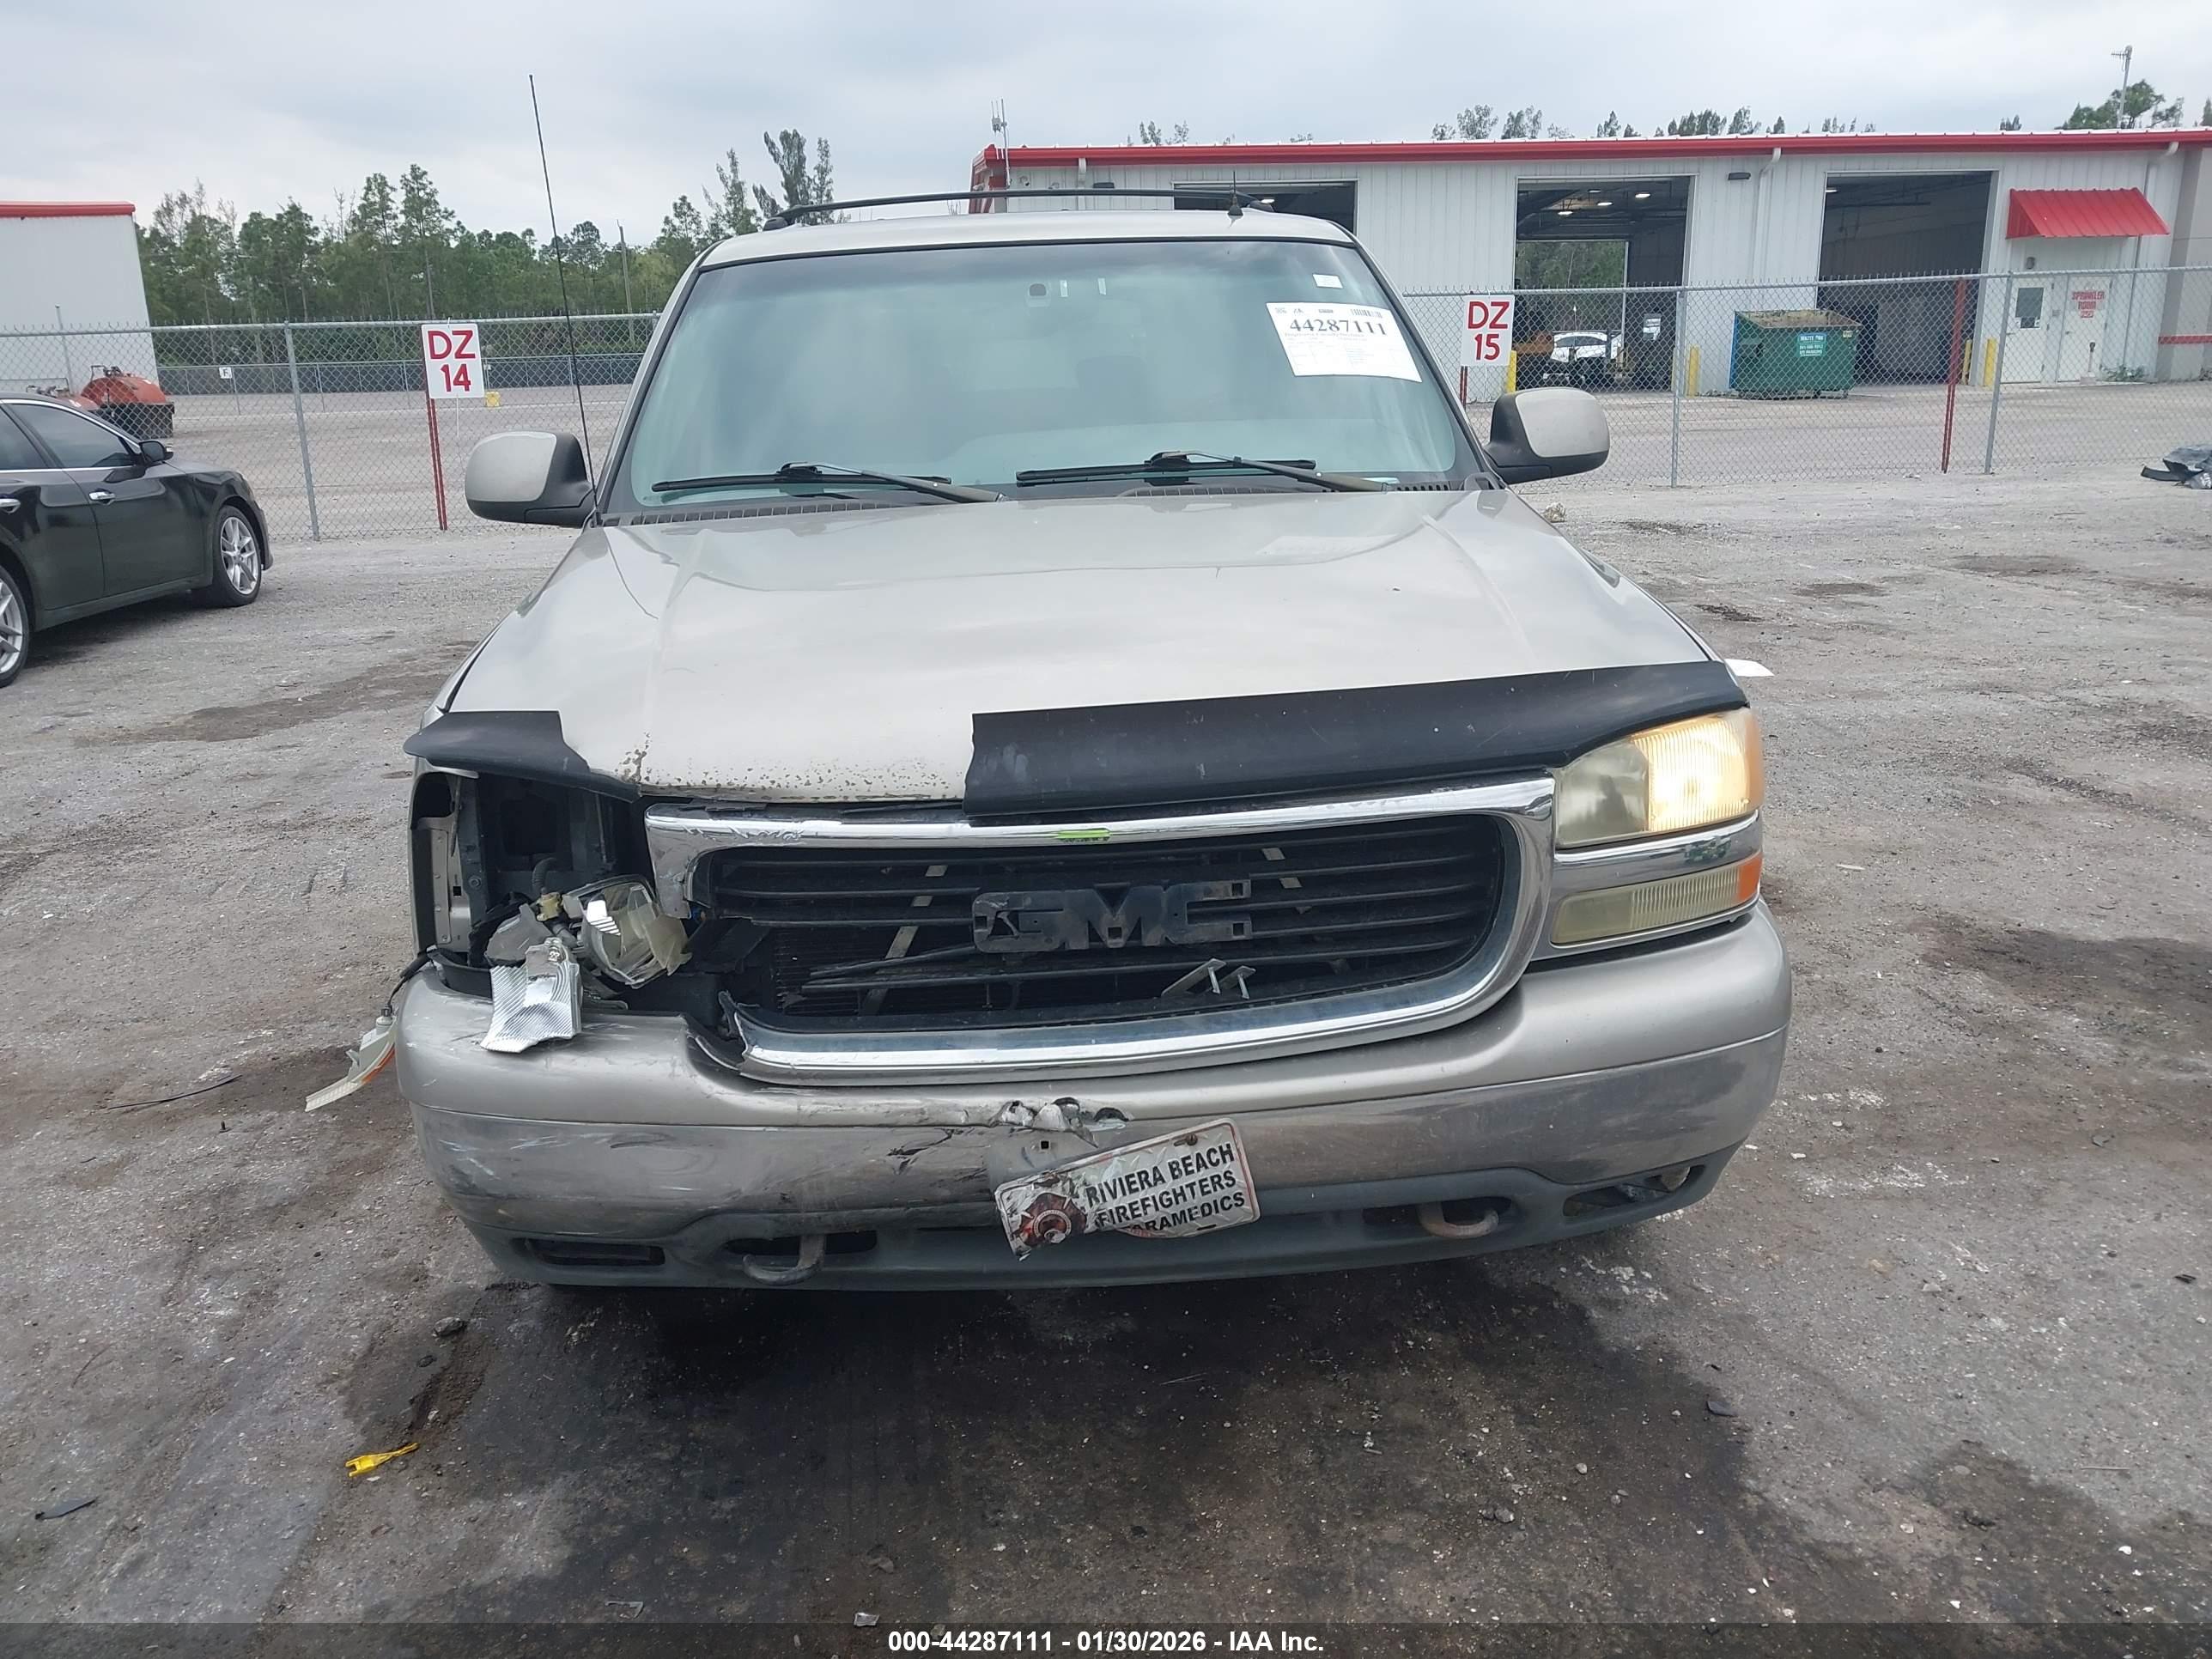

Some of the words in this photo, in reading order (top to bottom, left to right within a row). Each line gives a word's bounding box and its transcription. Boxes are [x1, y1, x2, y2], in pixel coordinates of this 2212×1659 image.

[1290, 319, 1387, 335] 44287111
[1468, 301, 1510, 329] DZ
[428, 330, 476, 359] DZ
[1474, 333, 1500, 361] 15
[440, 363, 471, 392] 14
[972, 879, 1251, 953] GMC
[1085, 1165, 1166, 1207] RIVIERA
[1168, 1143, 1235, 1181] BEACH
[1096, 1170, 1237, 1228] FIREFIGHTERS
[1120, 1192, 1245, 1231] ARAMEDICS
